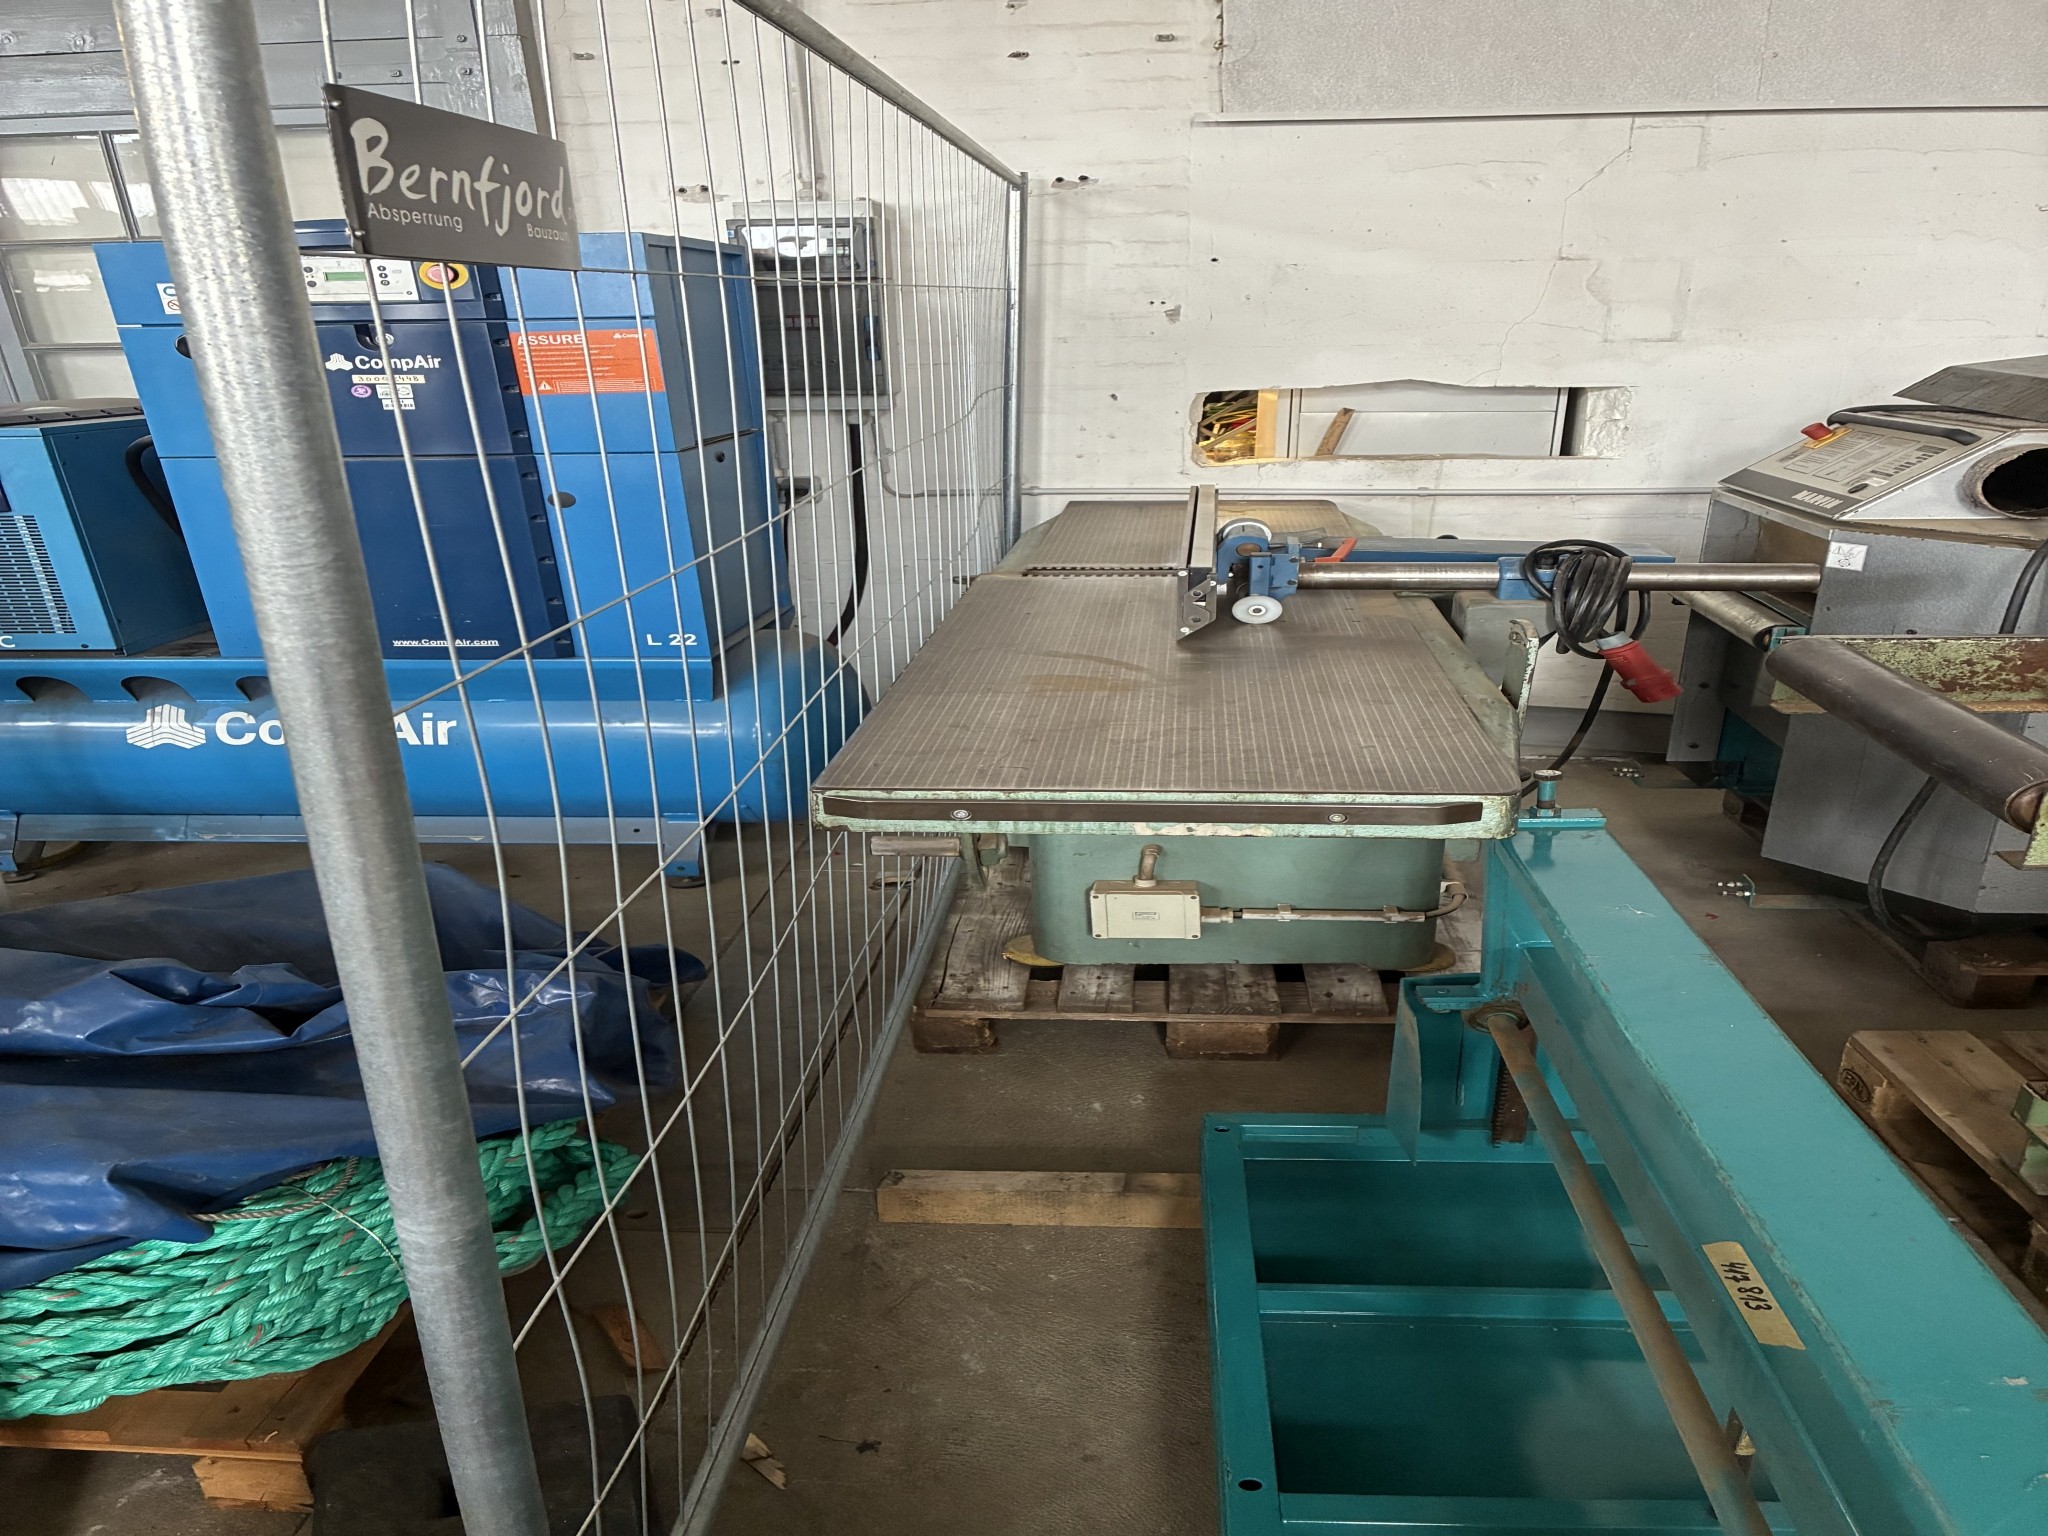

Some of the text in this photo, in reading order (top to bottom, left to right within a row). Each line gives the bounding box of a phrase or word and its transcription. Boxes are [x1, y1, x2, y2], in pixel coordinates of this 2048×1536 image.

[350, 117, 568, 237] Bernfjord
[367, 202, 463, 232] Absperrung
[392, 638, 500, 646] www.ComAir.com
[646, 633, 698, 646] L 22
[215, 711, 457, 746] CoAir
